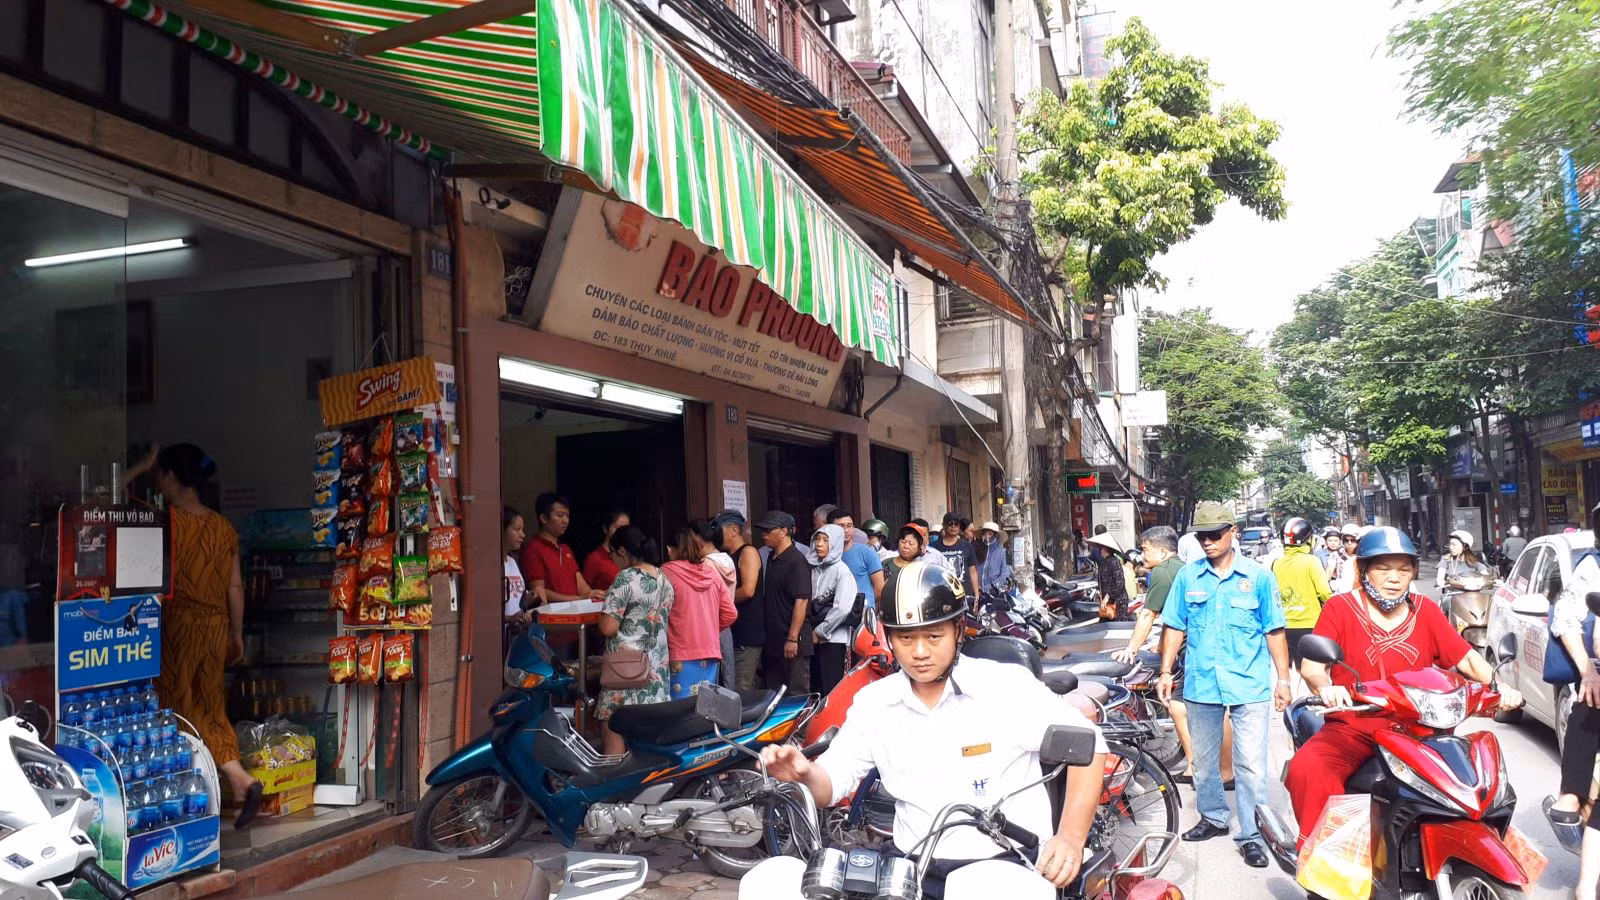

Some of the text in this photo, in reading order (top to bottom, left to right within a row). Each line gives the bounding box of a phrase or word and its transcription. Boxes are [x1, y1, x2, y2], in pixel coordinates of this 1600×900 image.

[431, 249, 450, 274] 181
[613, 335, 628, 348] 183
[360, 370, 400, 406] Swing
[107, 511, 125, 522] THU
[139, 511, 154, 523] BAO
[83, 625, 113, 642] ĐIỂM
[69, 634, 152, 671] SIM THẺ
